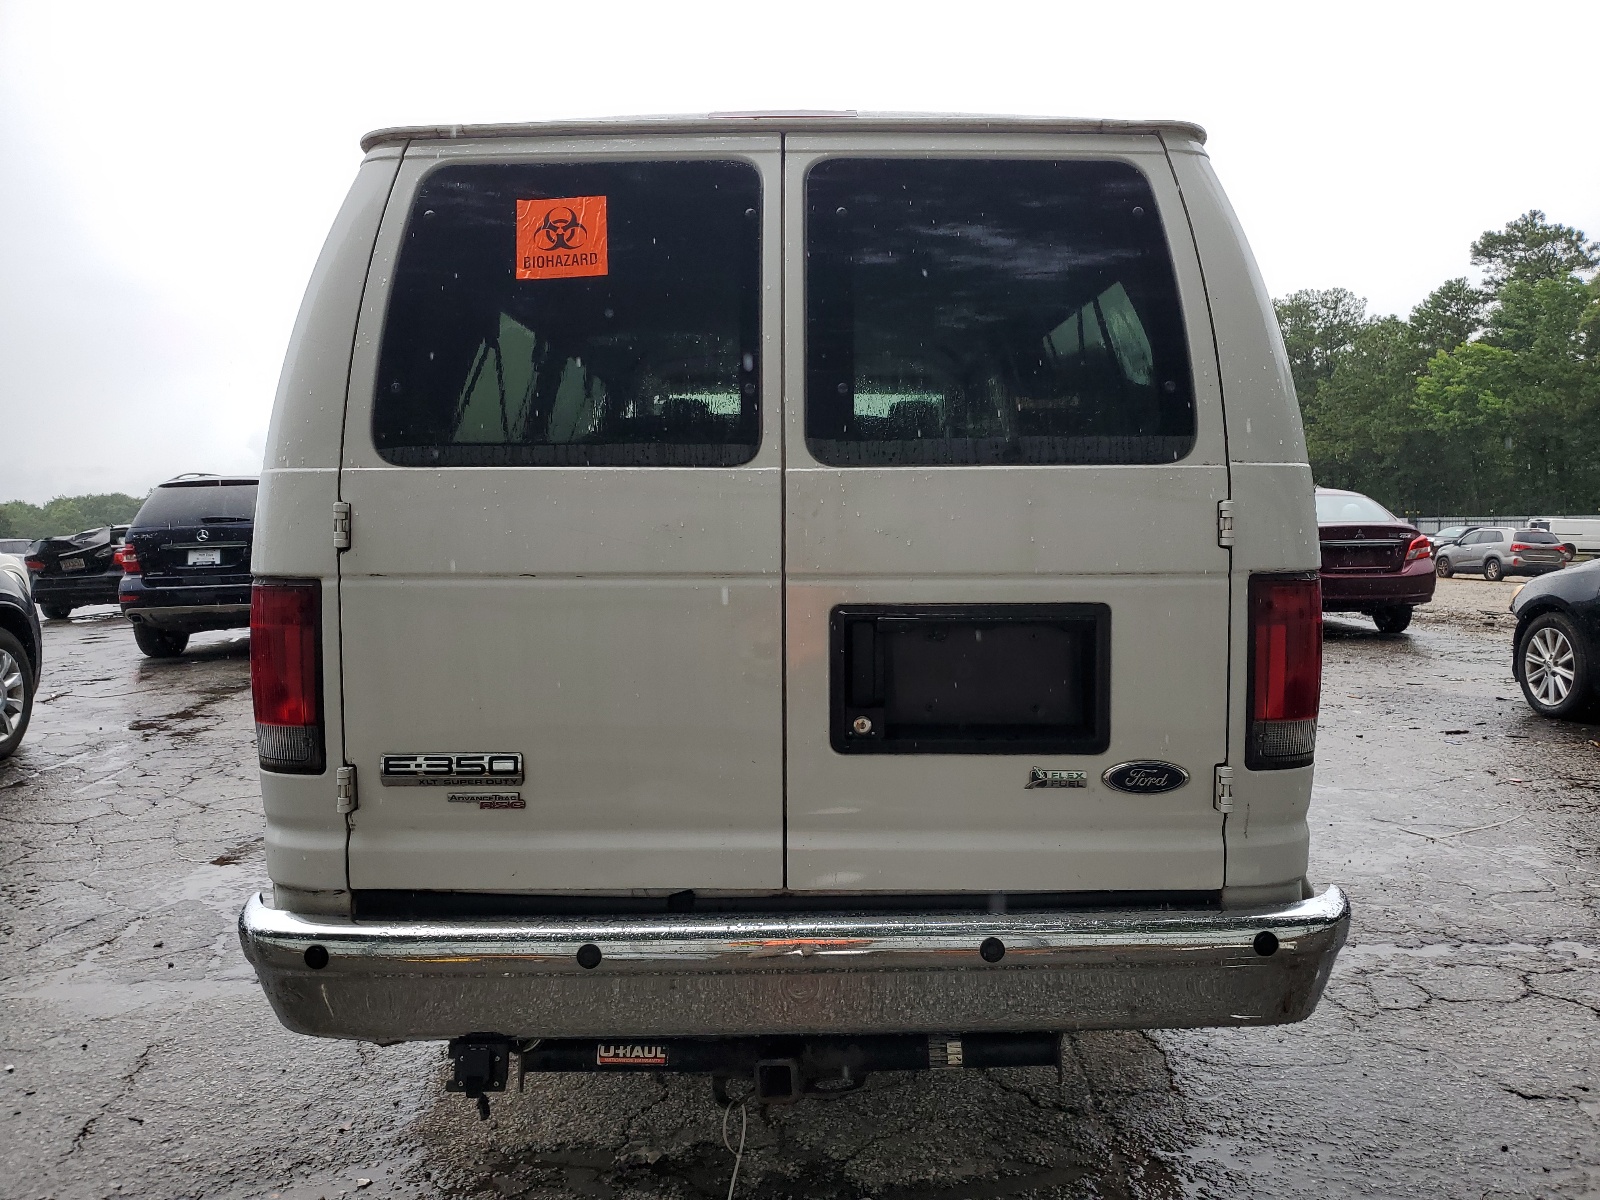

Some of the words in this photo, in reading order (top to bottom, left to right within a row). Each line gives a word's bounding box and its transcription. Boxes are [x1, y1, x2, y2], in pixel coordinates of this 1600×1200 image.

[523, 252, 598, 269] BIOHAZARD
[383, 756, 519, 775] E-350
[1125, 769, 1168, 787] Ford
